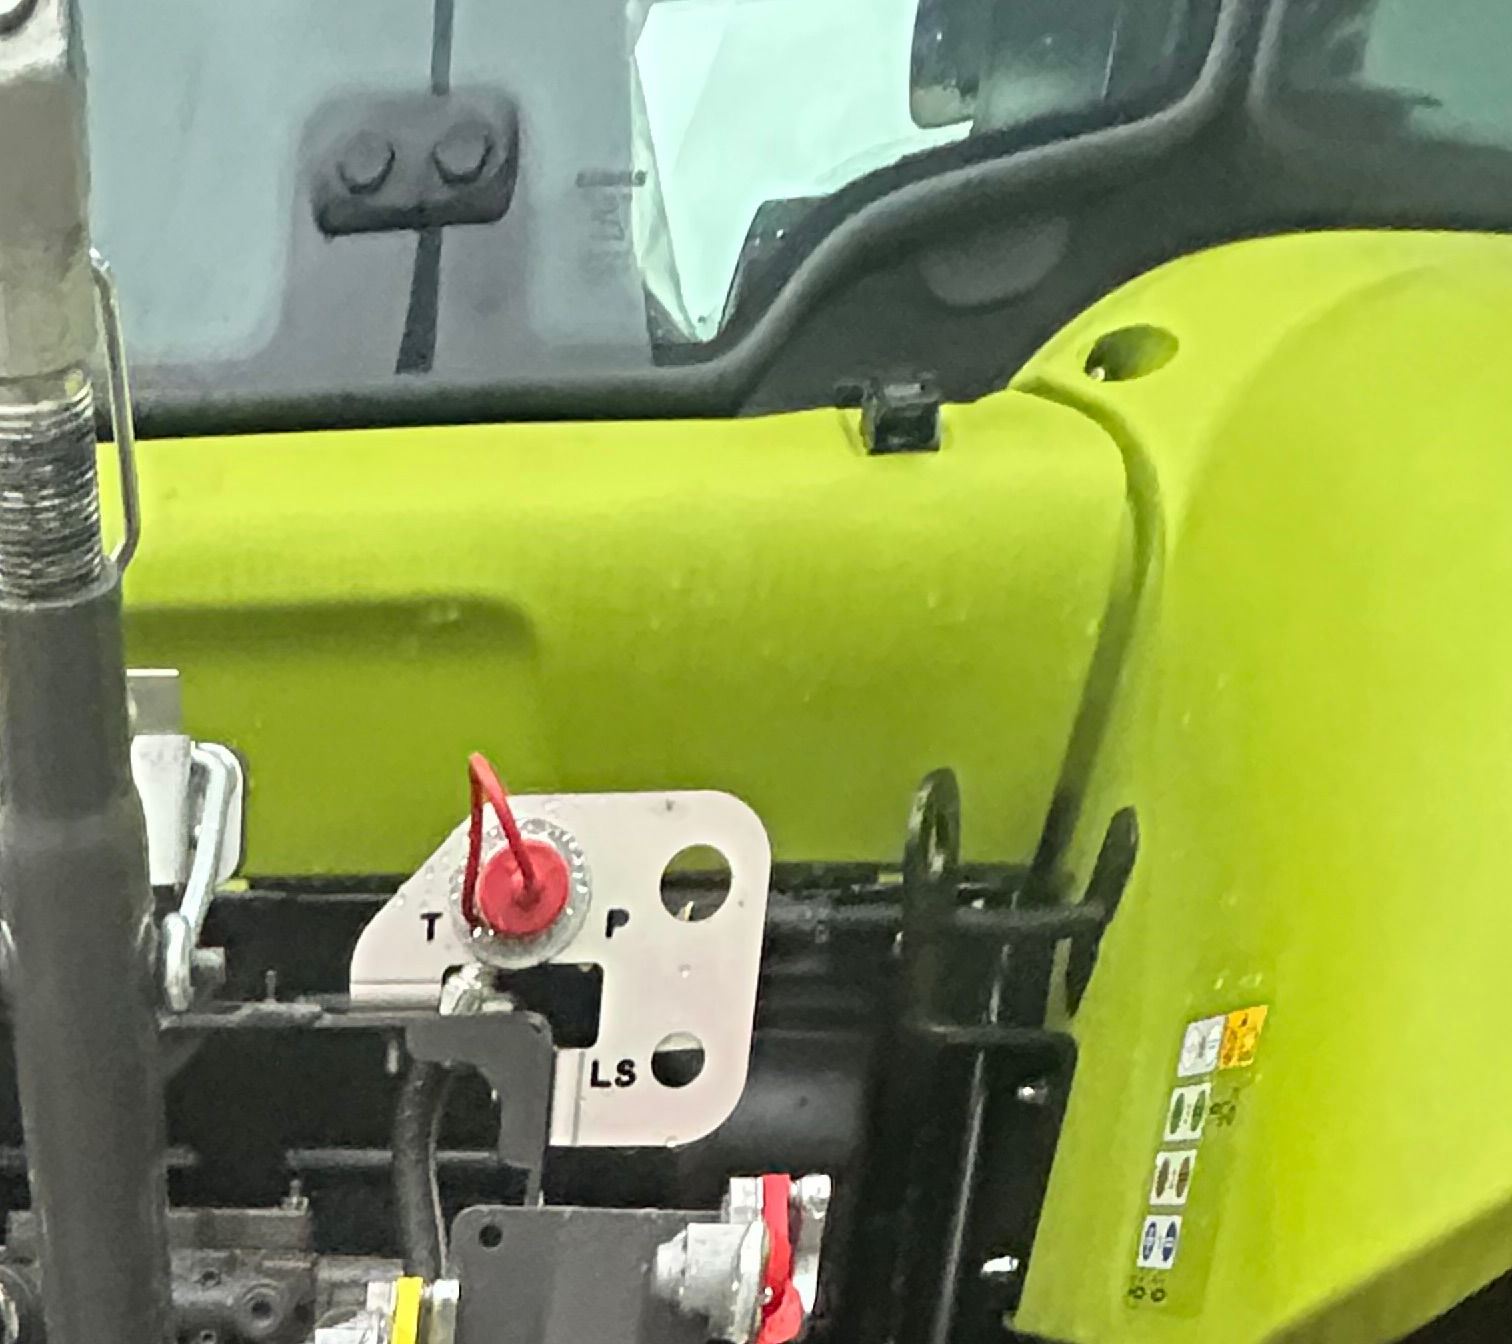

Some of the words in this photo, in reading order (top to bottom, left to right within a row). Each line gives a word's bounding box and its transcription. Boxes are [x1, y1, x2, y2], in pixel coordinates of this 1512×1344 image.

[420, 912, 443, 941] T
[605, 909, 630, 938] P
[590, 1059, 636, 1088] LS
